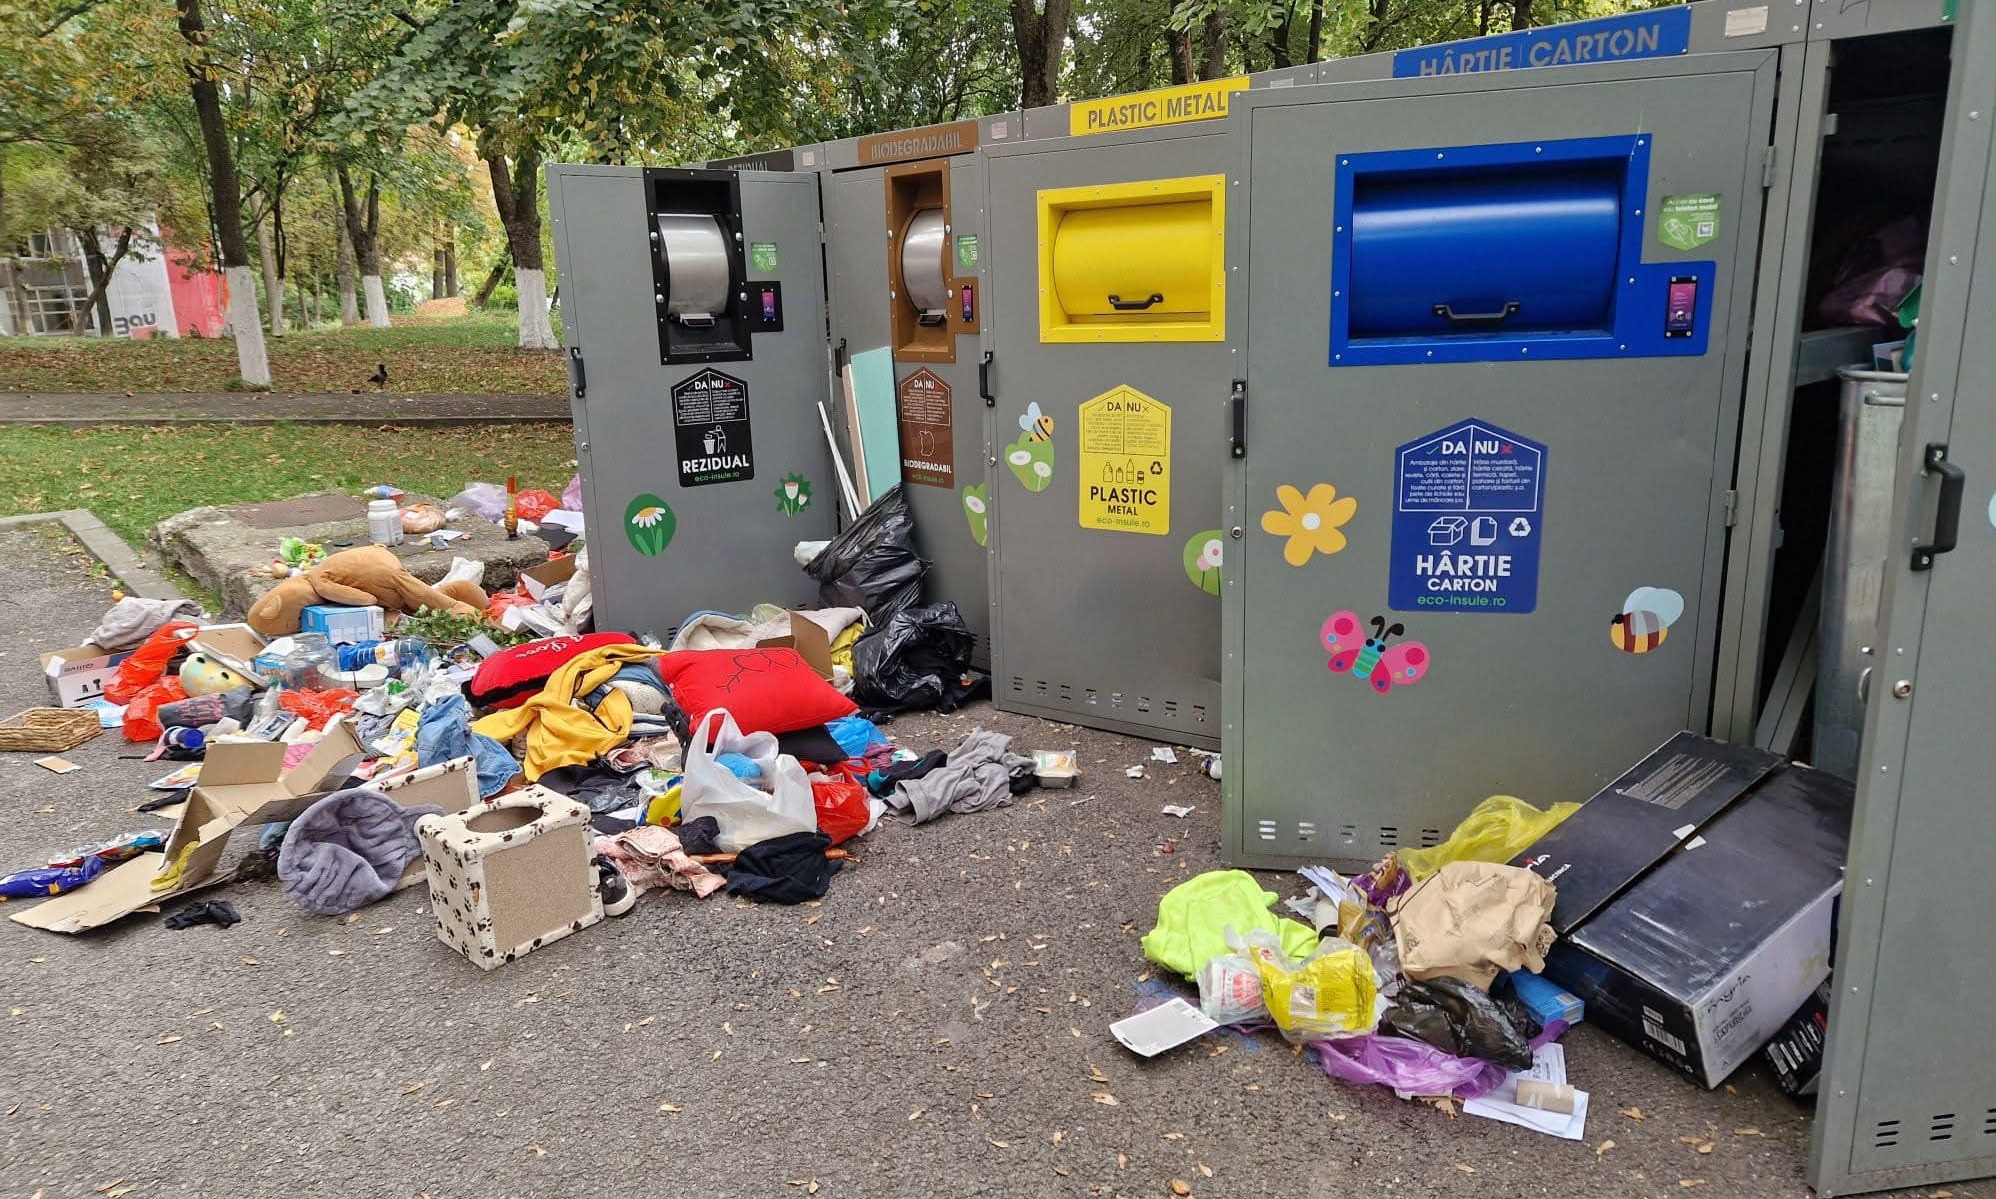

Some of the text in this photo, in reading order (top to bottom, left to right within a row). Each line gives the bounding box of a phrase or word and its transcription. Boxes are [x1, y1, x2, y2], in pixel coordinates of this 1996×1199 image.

[1419, 25, 1659, 77] HÂRTIE CARTON
[1088, 91, 1226, 129] PLASTIC METAL
[871, 132, 961, 160] BIODEGRADABIL
[694, 380, 724, 390] DA NU
[1107, 402, 1141, 412] DA NU
[1442, 441, 1499, 455] DA NU
[682, 454, 750, 474] REZIDUAL
[1090, 486, 1157, 506] PLASTIC
[1107, 504, 1138, 516] METAL
[1416, 550, 1512, 576] HÂRTIE
[1427, 578, 1497, 592] CARTON
[1417, 595, 1506, 607] eco-insule.ro
